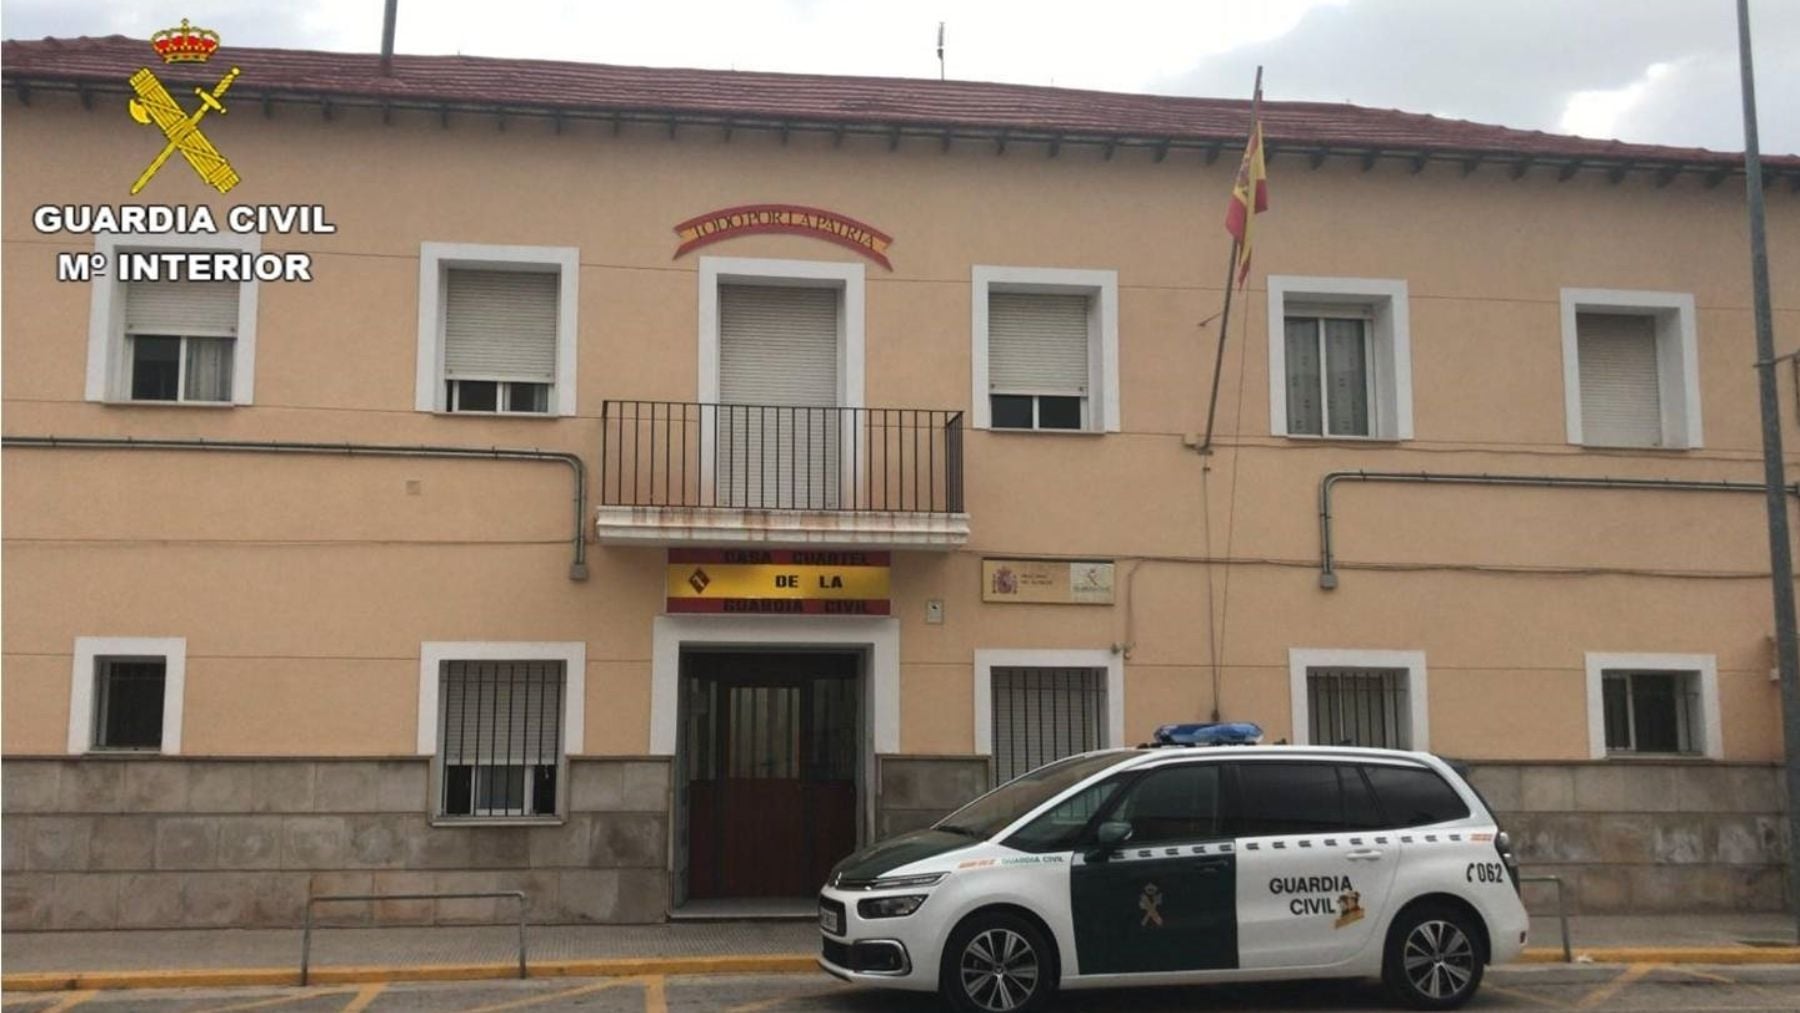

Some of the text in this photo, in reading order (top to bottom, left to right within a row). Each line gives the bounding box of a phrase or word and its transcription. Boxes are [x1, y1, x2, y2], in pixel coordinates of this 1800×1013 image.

[694, 210, 875, 251] TODO POR LA PATRIA
[775, 575, 843, 589] DE LA
[723, 599, 867, 614] GUARDIA CIVIL
[1002, 856, 1041, 865] GUARDIA
[1476, 862, 1503, 883] 062
[1269, 876, 1353, 895] GUARDIA
[1290, 898, 1336, 915] CIVIL
